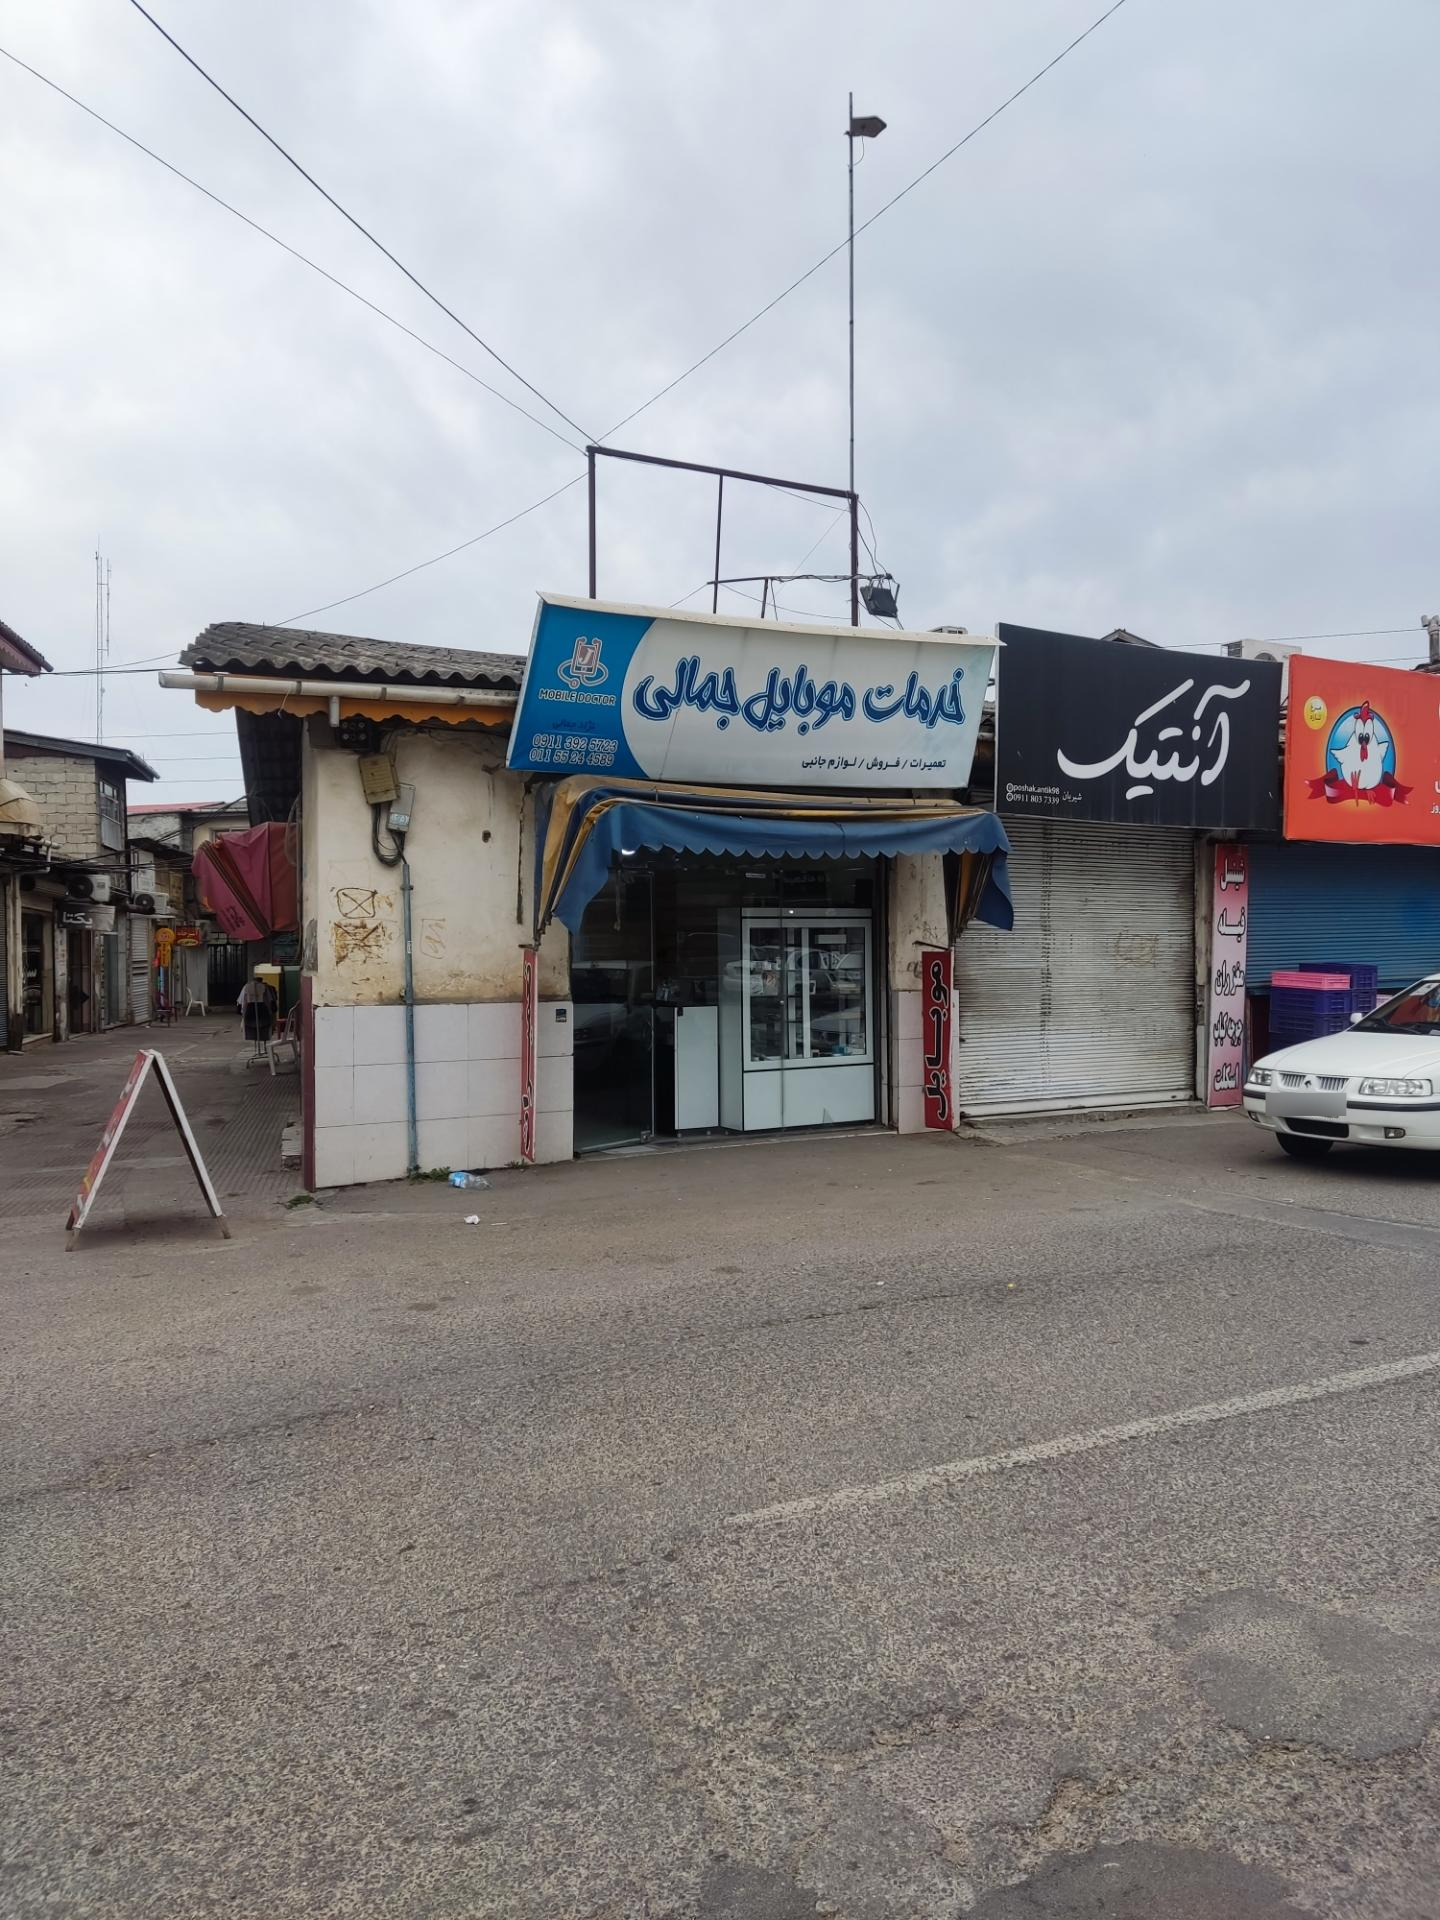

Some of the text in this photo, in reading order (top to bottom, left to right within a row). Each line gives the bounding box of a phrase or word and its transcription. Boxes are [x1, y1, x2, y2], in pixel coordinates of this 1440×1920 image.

[539, 688, 616, 706] MOBILE DOCTOR
[633, 655, 966, 736] خدمات موبایل جمالی
[532, 733, 618, 753] 0911 392 5723
[1057, 678, 1250, 800] آنتیک
[529, 748, 552, 762] 011
[552, 750, 569, 764] 55
[569, 752, 585, 765] 24
[801, 755, 826, 769] جانبی
[827, 756, 857, 770] لوازم
[866, 757, 900, 770] فروش
[909, 757, 947, 771] تعمیرات
[1013, 793, 1029, 802] 0911
[1030, 795, 1043, 803] 803
[63, 911, 93, 929] یکتا
[1217, 906, 1246, 943] فیله
[1213, 1011, 1229, 1047] کباب
